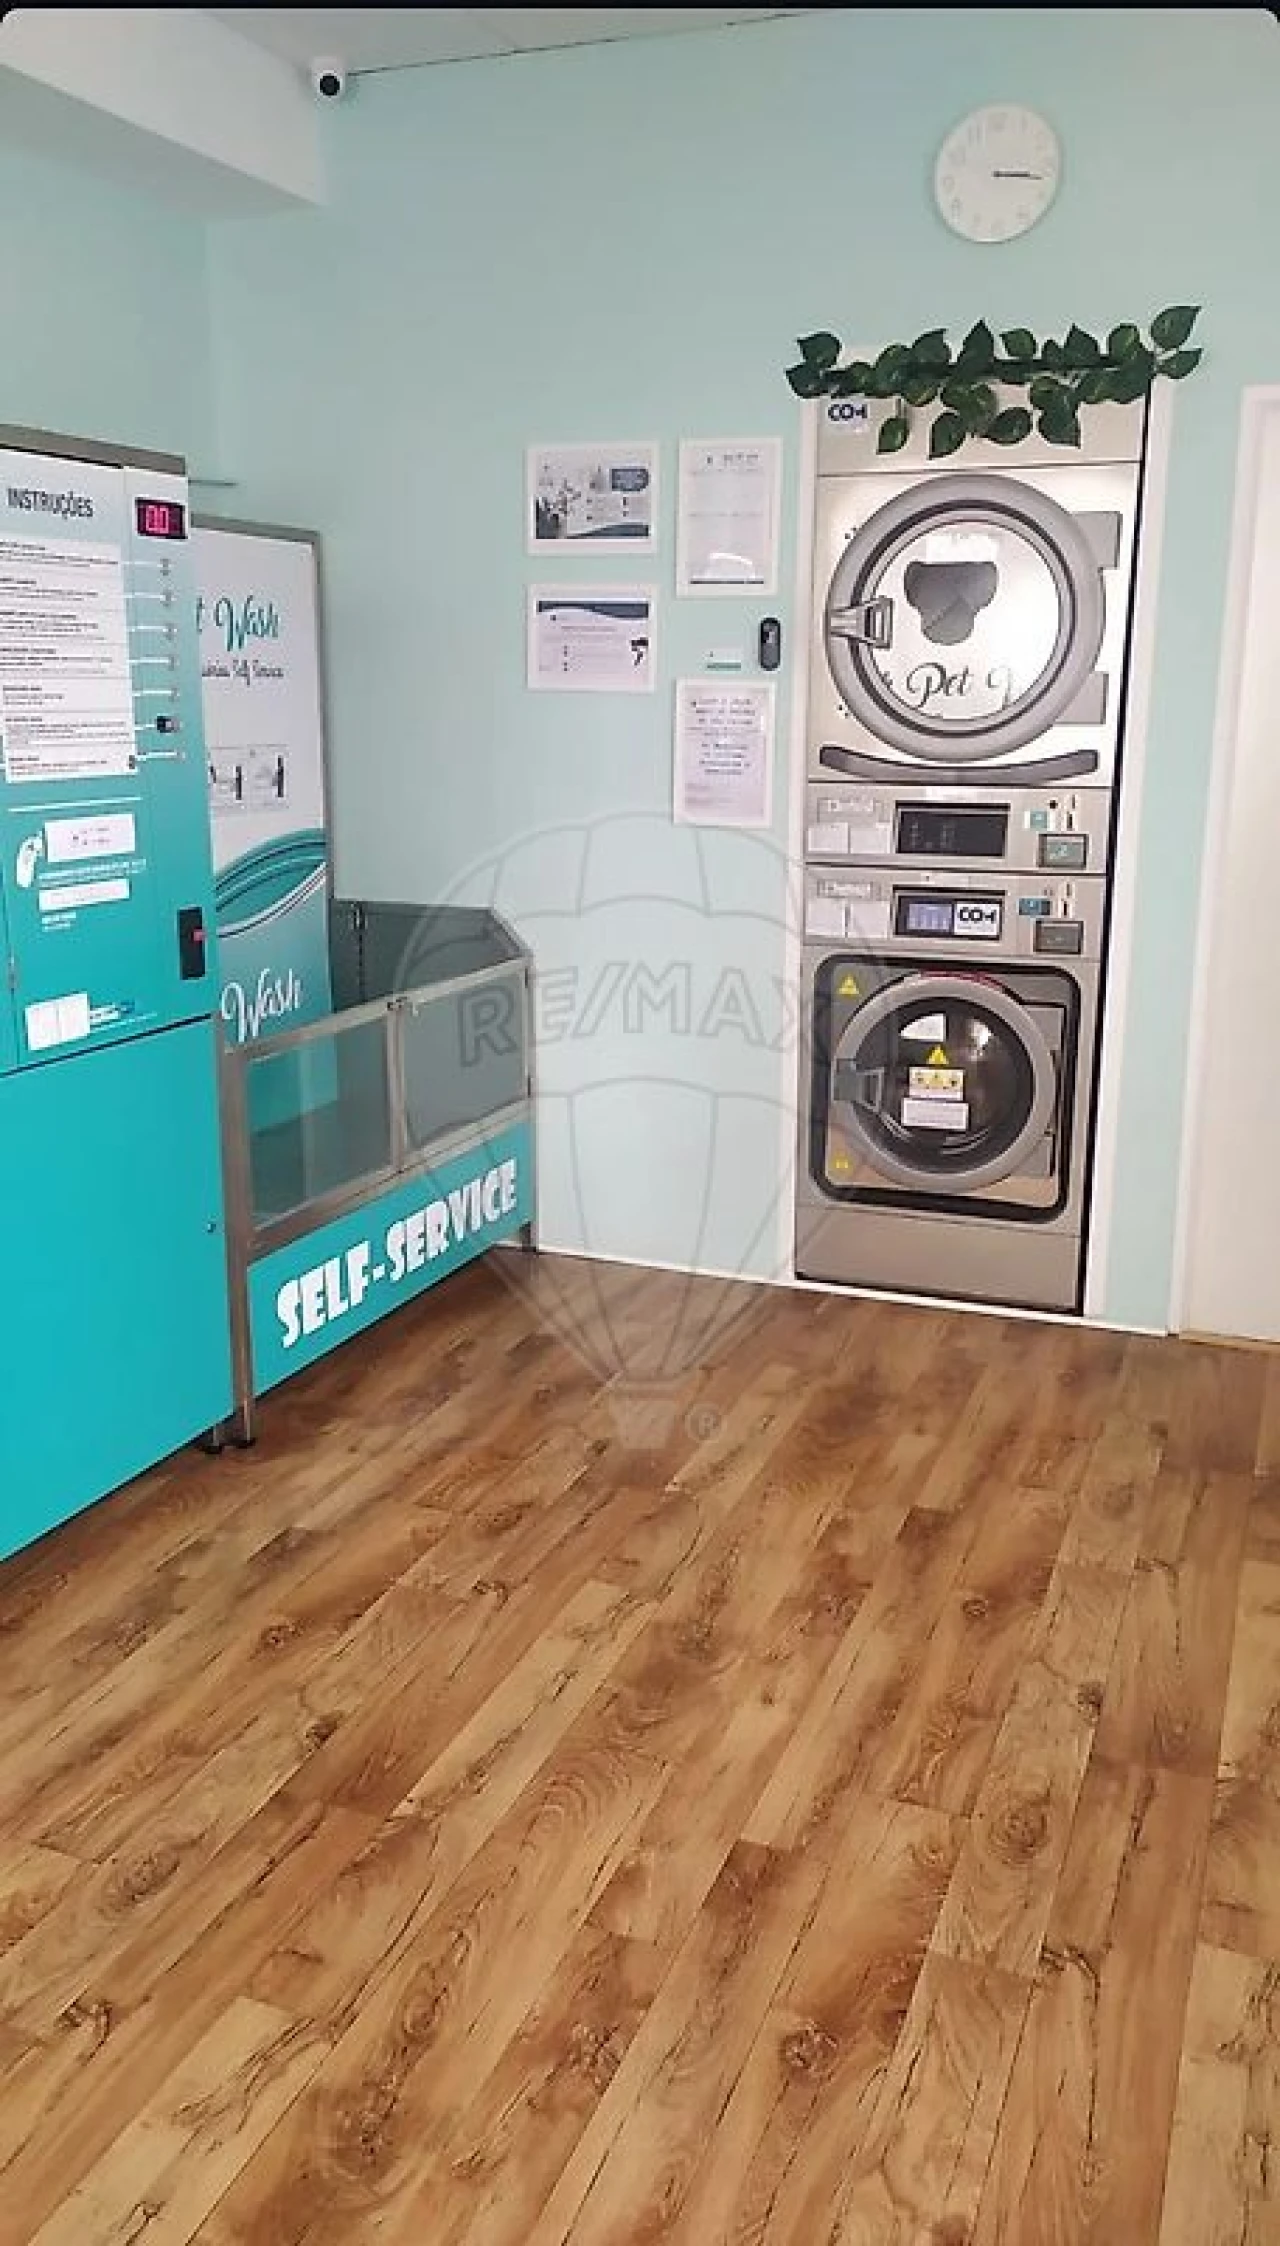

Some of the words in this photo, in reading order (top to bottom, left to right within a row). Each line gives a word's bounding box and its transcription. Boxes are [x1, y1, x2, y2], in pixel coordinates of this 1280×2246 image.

[7, 487, 95, 520] INSTRUÇÕES
[213, 594, 280, 652] Wash
[906, 662, 976, 710] Pet
[219, 968, 302, 1042] Wash
[276, 1158, 519, 1349] SELF-SERVICE
